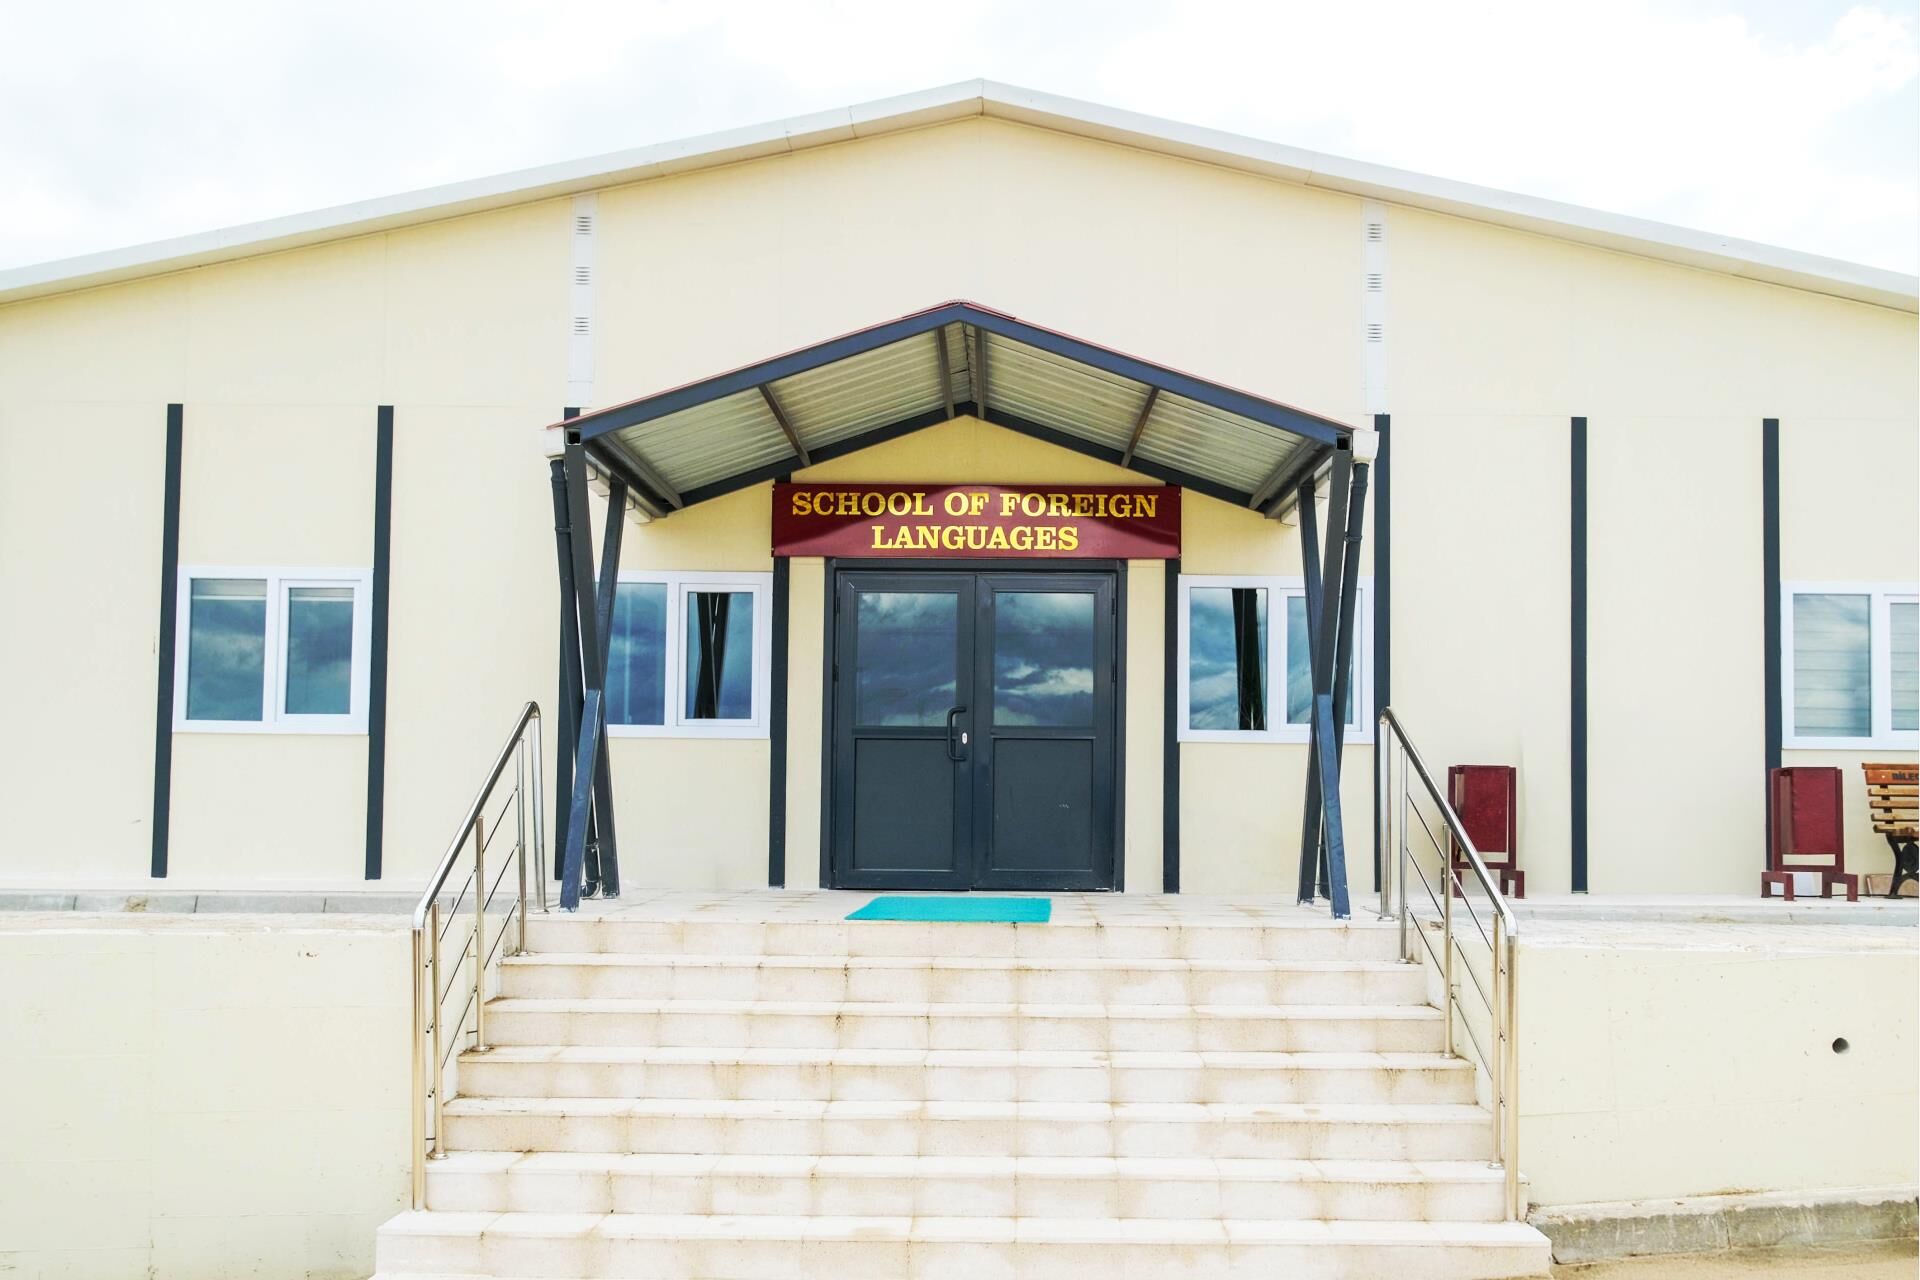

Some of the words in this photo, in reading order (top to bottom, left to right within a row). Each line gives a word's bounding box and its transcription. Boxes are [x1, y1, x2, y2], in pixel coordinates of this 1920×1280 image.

[791, 492, 934, 516] SCHOOL
[943, 491, 990, 517] OF
[999, 492, 1159, 518] FOREIGN
[871, 525, 1079, 551] LANGUAGES
